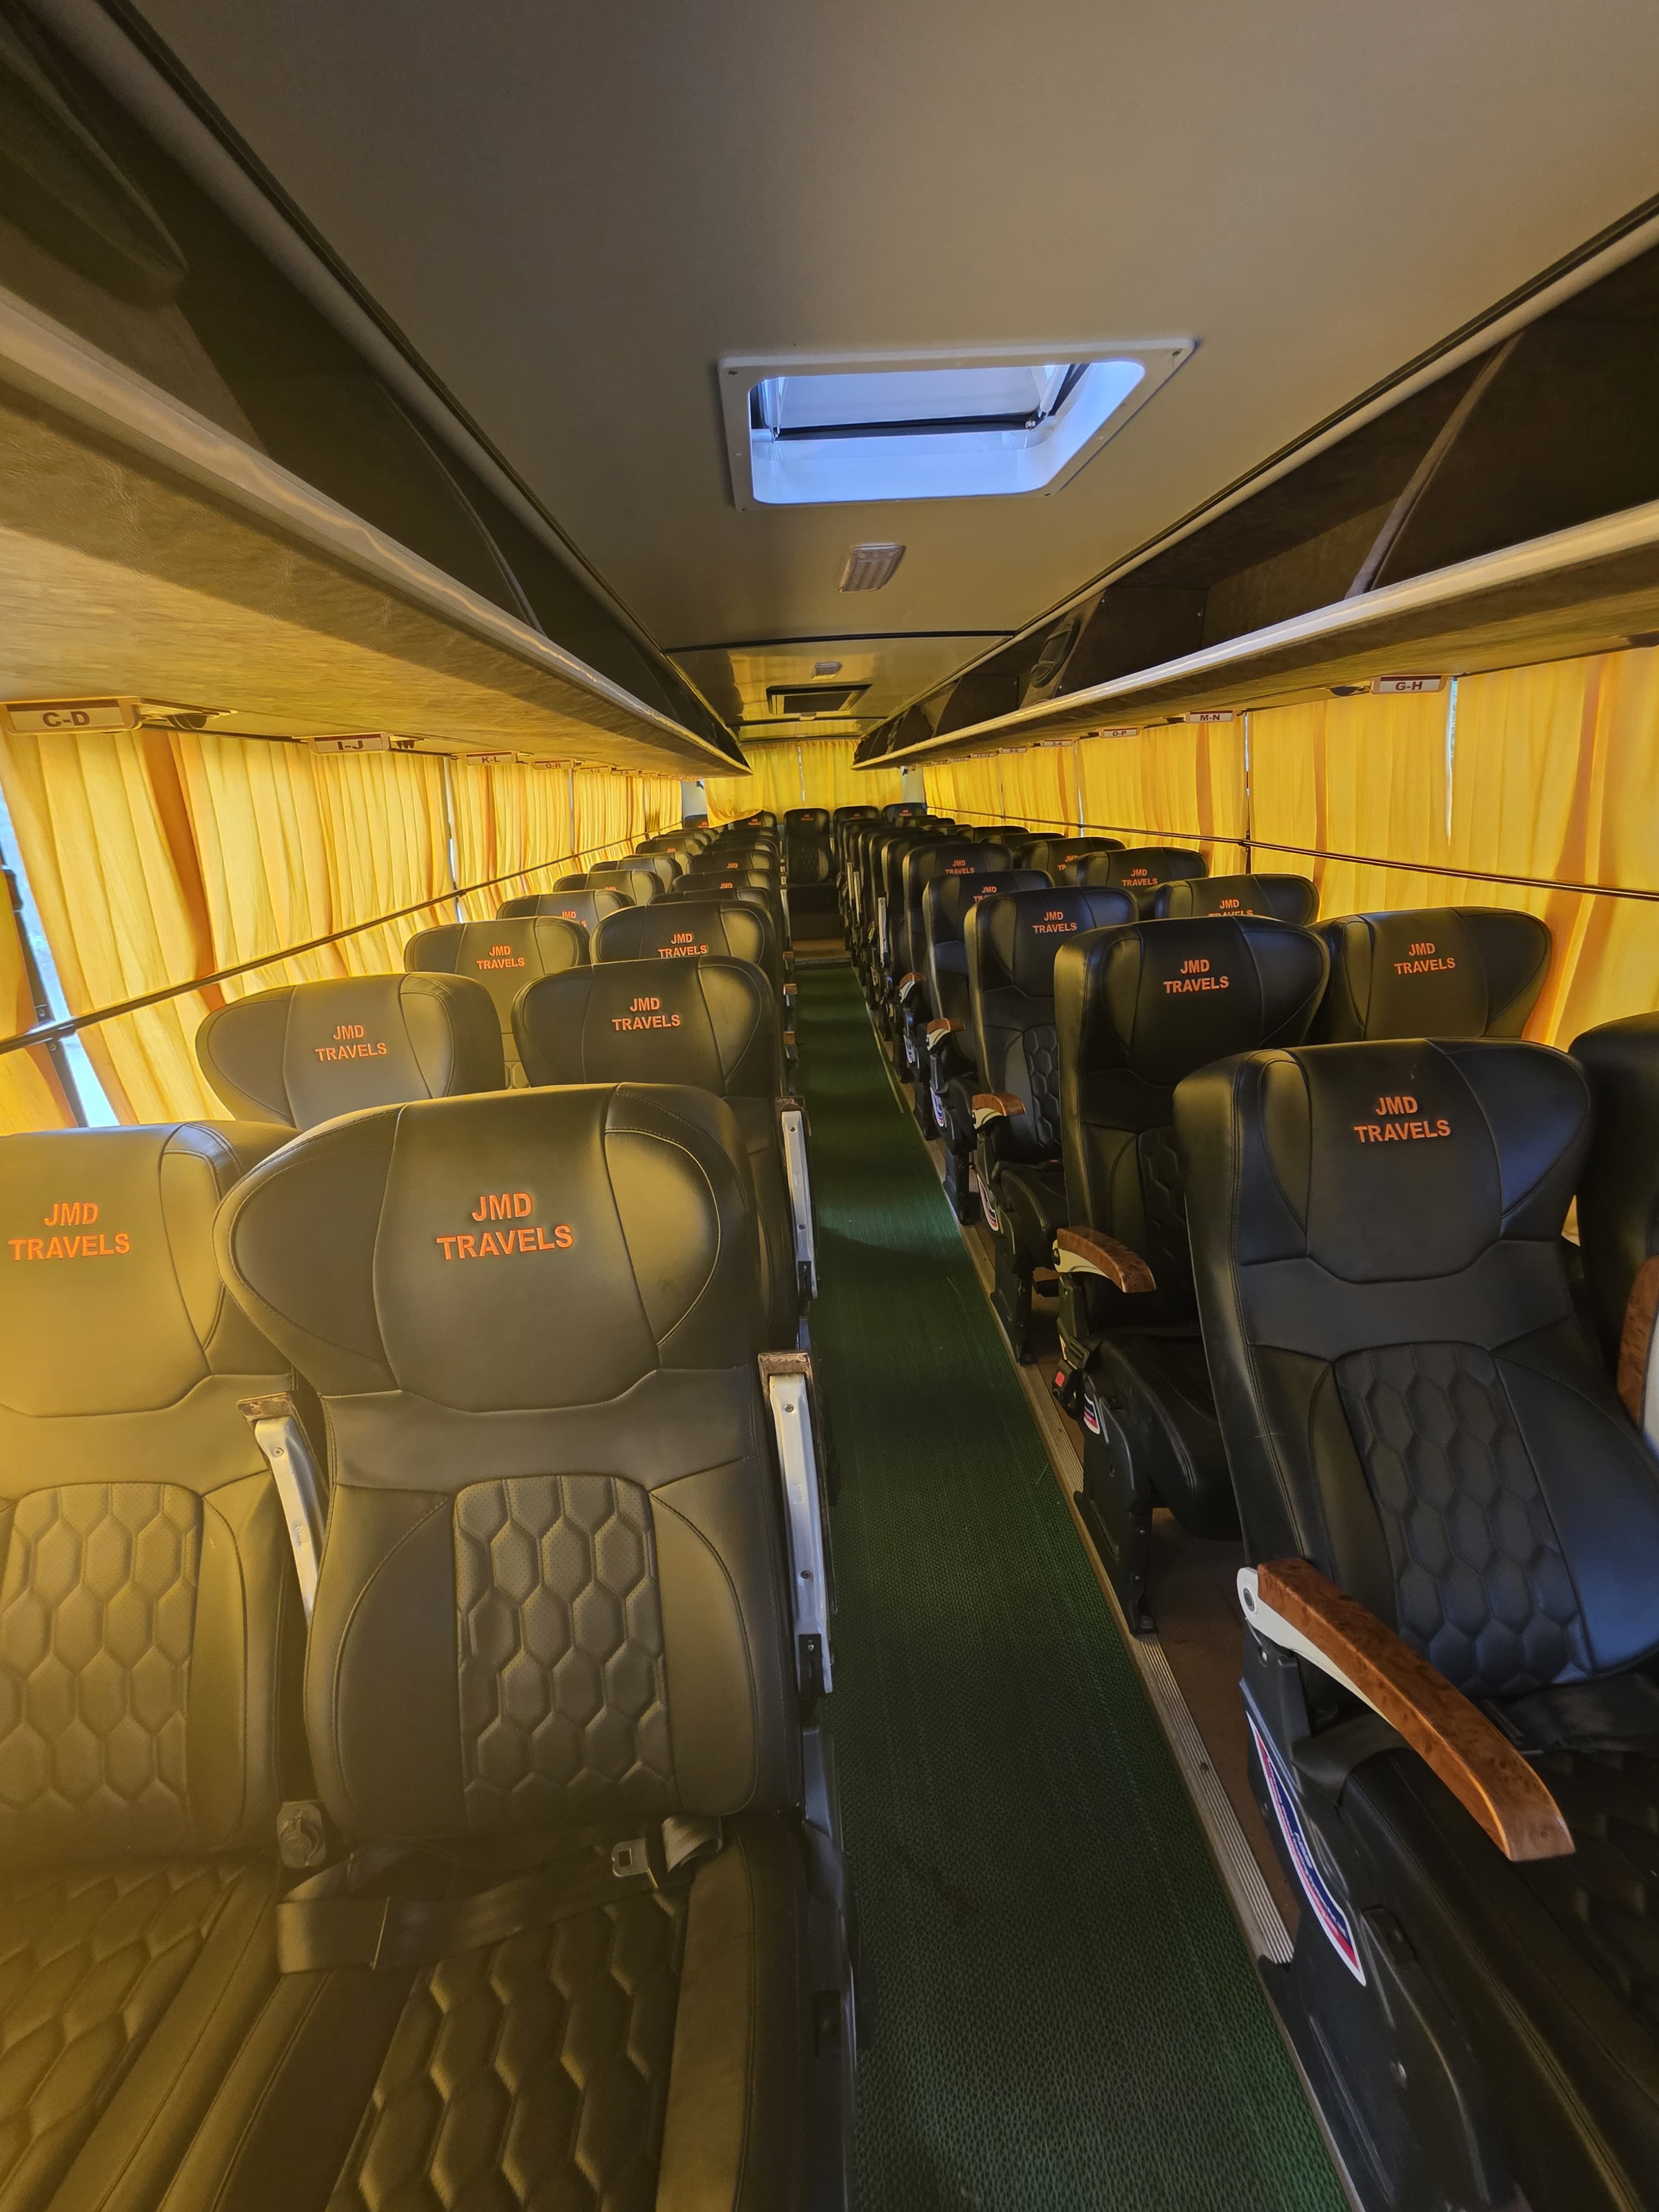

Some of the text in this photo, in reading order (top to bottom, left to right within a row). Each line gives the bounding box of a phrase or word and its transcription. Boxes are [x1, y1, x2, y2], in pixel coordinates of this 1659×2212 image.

[1395, 681, 1423, 691] G-H
[43, 711, 90, 727] C-D
[337, 740, 364, 750] I-J
[1121, 877, 1158, 886] TRAVELS
[1219, 899, 1240, 909] JMD
[560, 911, 576, 919] JMD
[1044, 911, 1063, 921] JMD
[1032, 922, 1077, 933] TRAVELS
[671, 932, 693, 944] JMD
[489, 945, 511, 957] JMD
[658, 944, 708, 957] TRAVELS
[1408, 942, 1436, 956] JMD
[476, 956, 525, 971] TRAVELS
[1180, 959, 1210, 974] JMD
[1394, 957, 1455, 974] TRAVELS
[1164, 976, 1229, 994] TRAVELS
[630, 997, 661, 1012] JMD
[612, 1014, 681, 1031] TRAVELS
[333, 1025, 365, 1041] JMD
[315, 1042, 388, 1062] TRAVELS
[1375, 1096, 1418, 1115] JMD
[1353, 1119, 1451, 1143] TRAVELS
[471, 1192, 533, 1222] JMD
[43, 1202, 100, 1228] JMD
[7, 1232, 132, 1262] TRAVELS
[436, 1224, 574, 1262] TRAVELS
